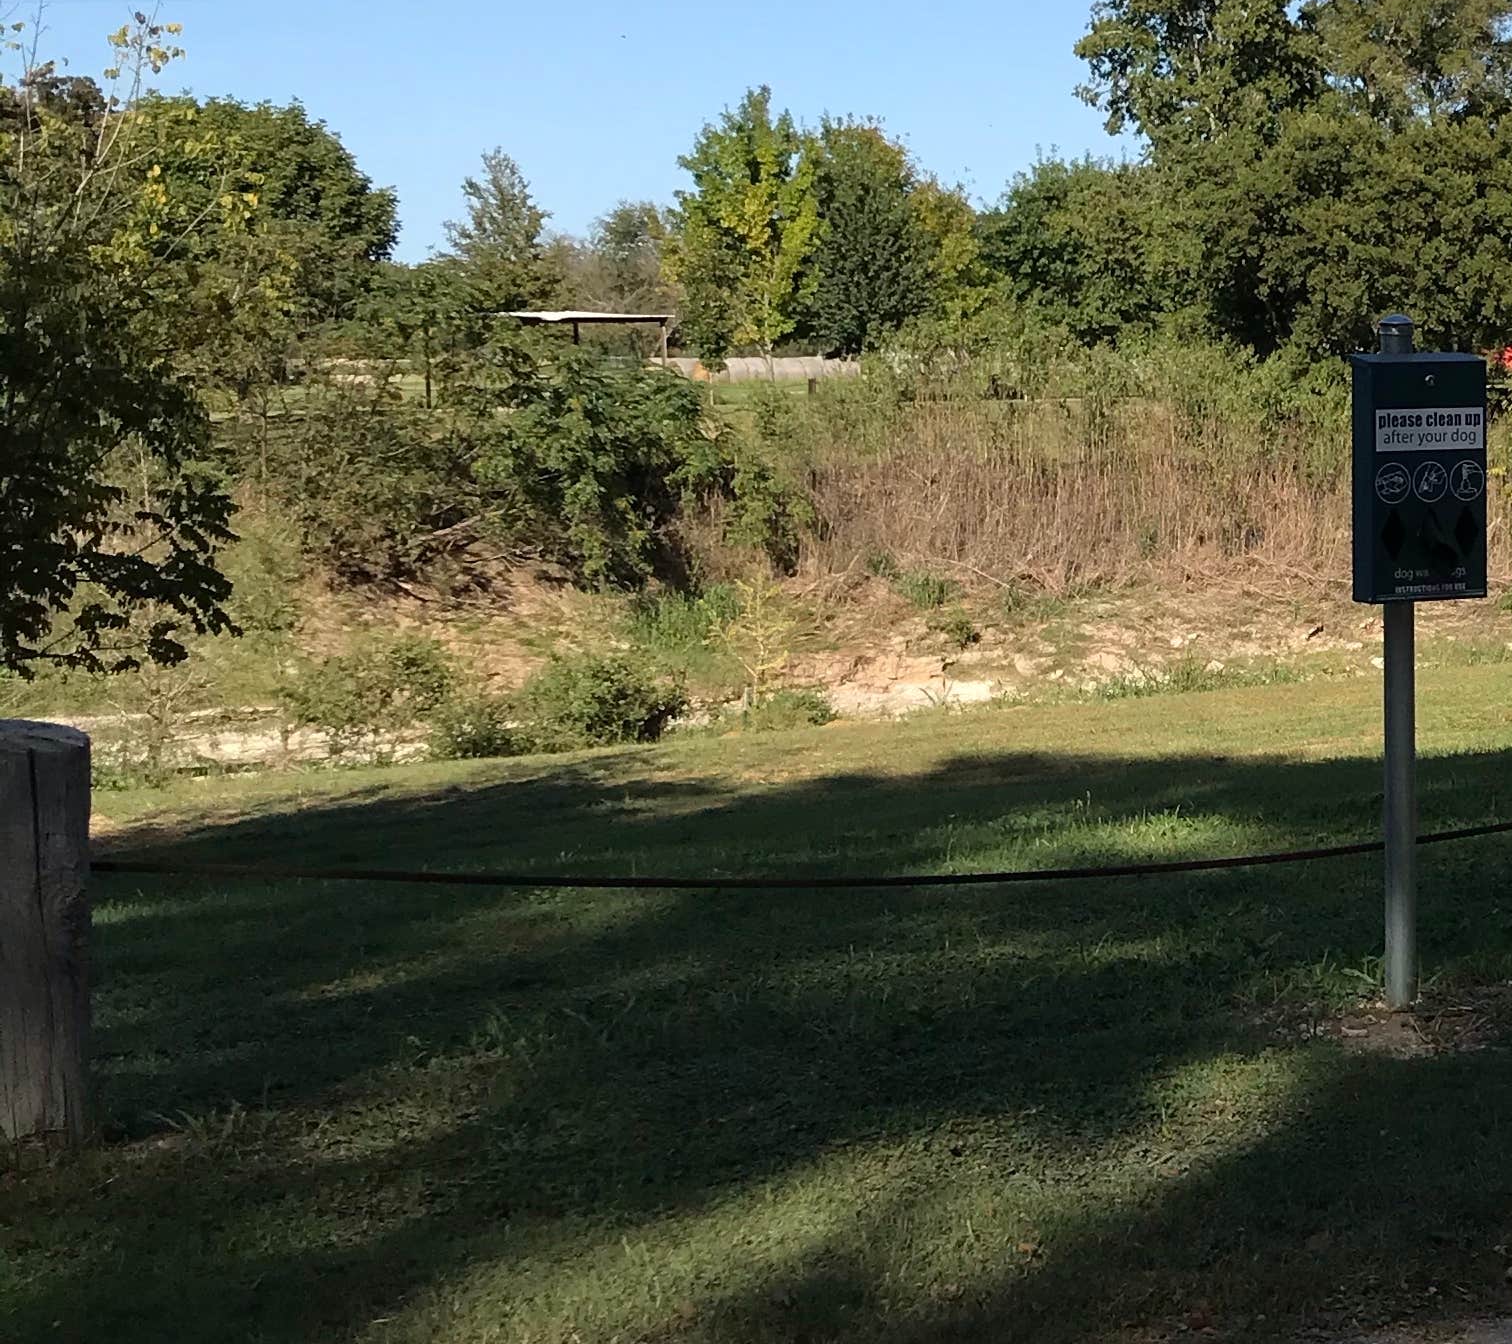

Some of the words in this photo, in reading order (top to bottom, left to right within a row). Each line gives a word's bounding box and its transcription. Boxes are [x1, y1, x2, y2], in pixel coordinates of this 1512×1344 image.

[1378, 413, 1423, 430] please
[1426, 412, 1462, 427] clean
[1464, 413, 1481, 428] up
[1383, 430, 1415, 444] after
[1417, 432, 1448, 447] your
[1450, 427, 1477, 445] dog
[1394, 568, 1414, 581] dog
